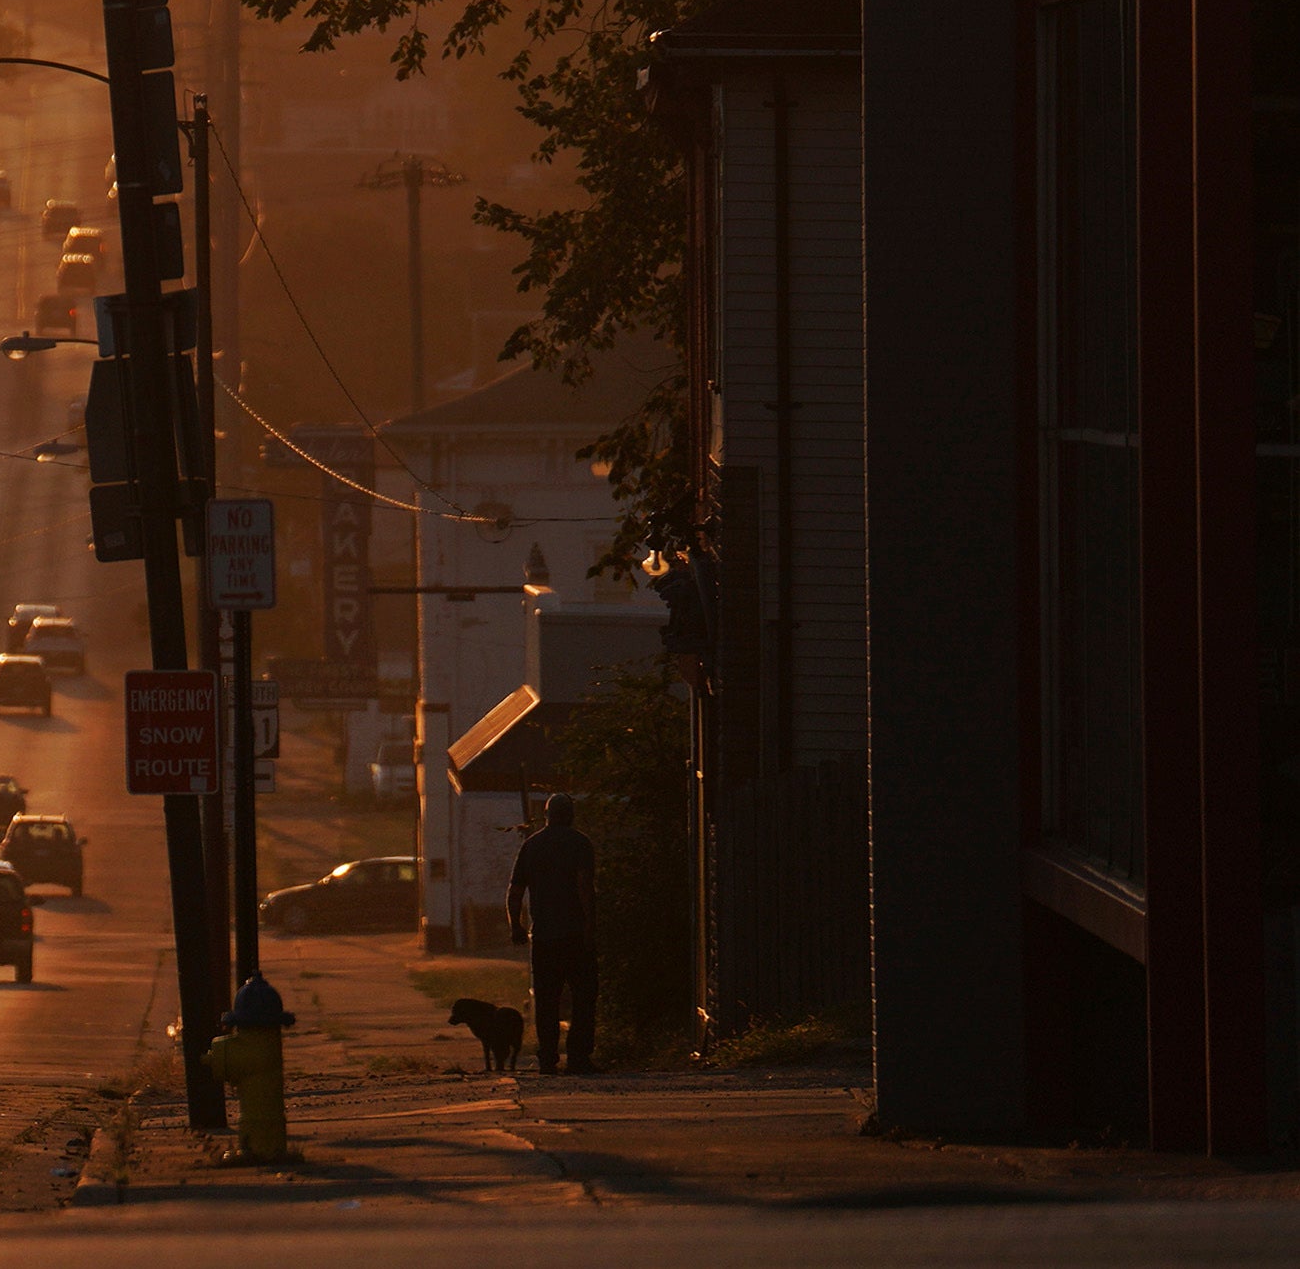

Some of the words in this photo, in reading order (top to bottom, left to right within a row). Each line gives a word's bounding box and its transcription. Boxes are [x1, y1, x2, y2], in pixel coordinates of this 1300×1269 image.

[228, 508, 252, 529] NO
[211, 534, 270, 555] PARKING
[228, 557, 254, 571] ANY
[227, 573, 257, 589] TIME
[131, 689, 212, 712] EMERGENCY
[139, 727, 204, 744] SNOW
[135, 759, 211, 776] ROUTE
